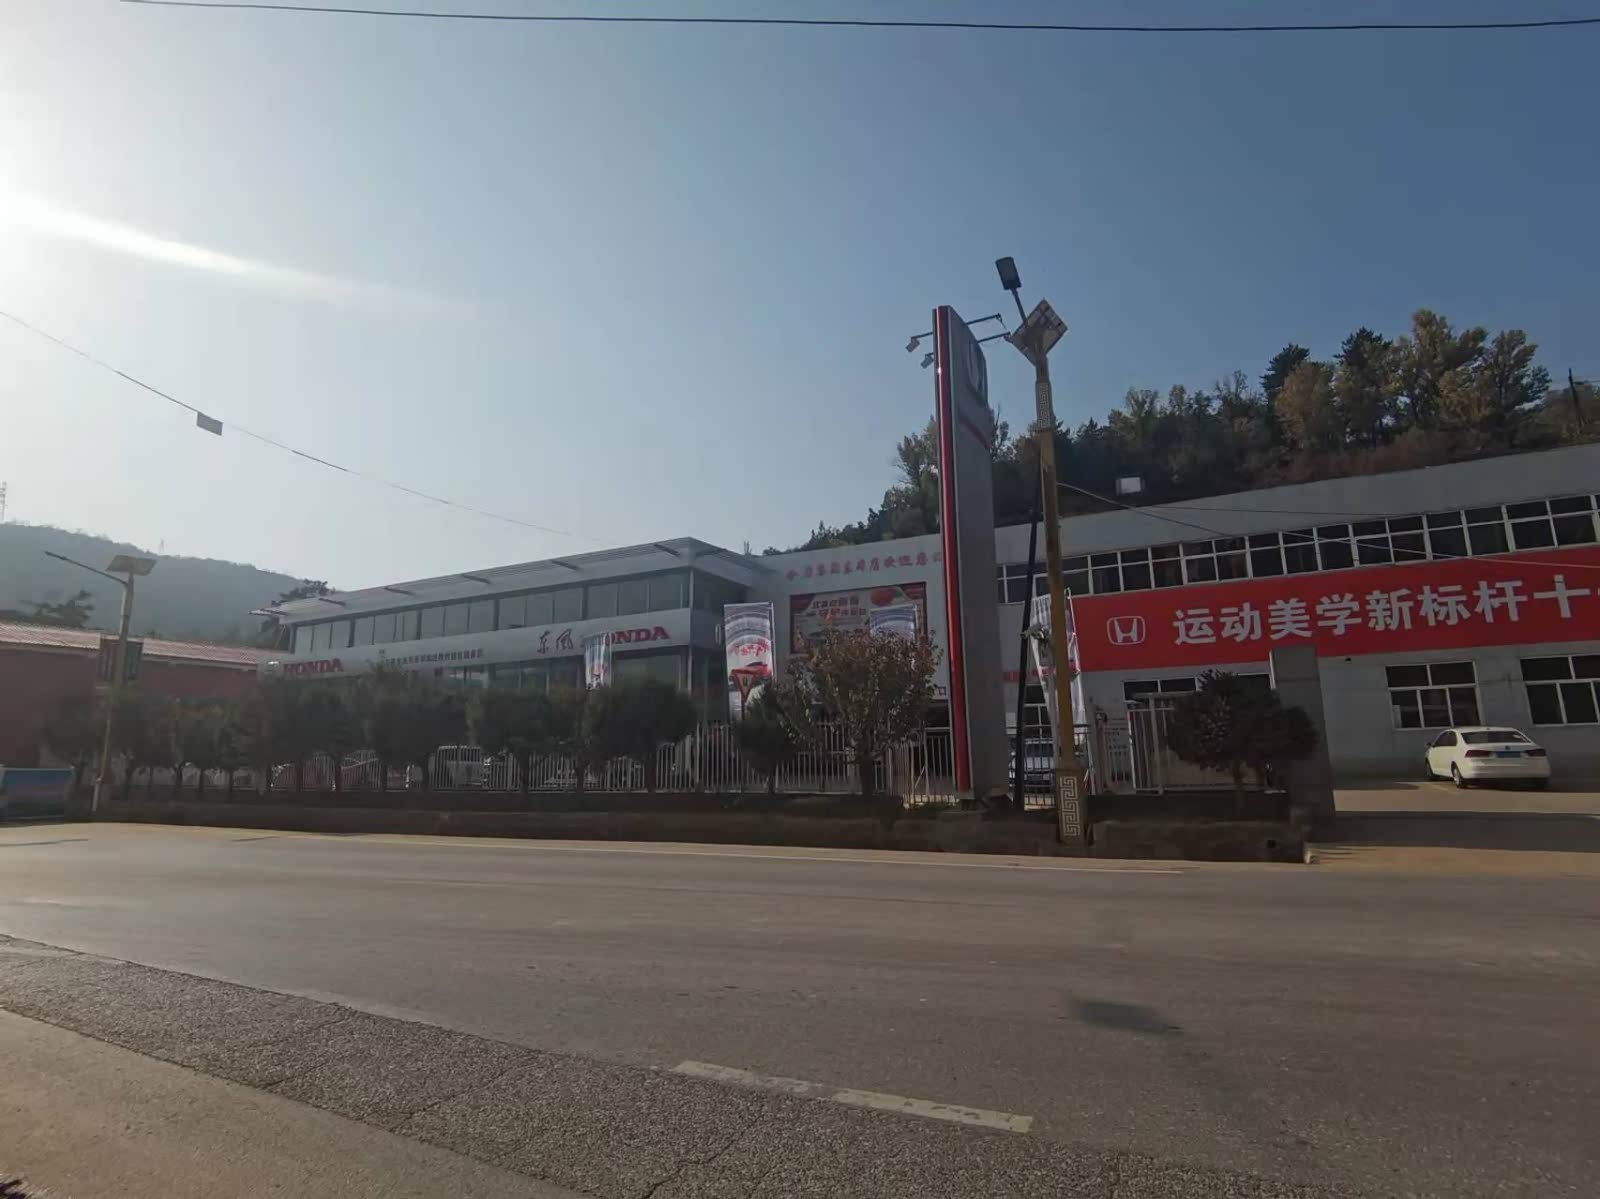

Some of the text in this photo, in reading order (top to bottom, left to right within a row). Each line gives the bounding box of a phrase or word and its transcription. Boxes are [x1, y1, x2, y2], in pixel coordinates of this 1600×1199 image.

[1173, 574, 1600, 645] 运动美学新标杆十
[600, 626, 671, 647] ONDA
